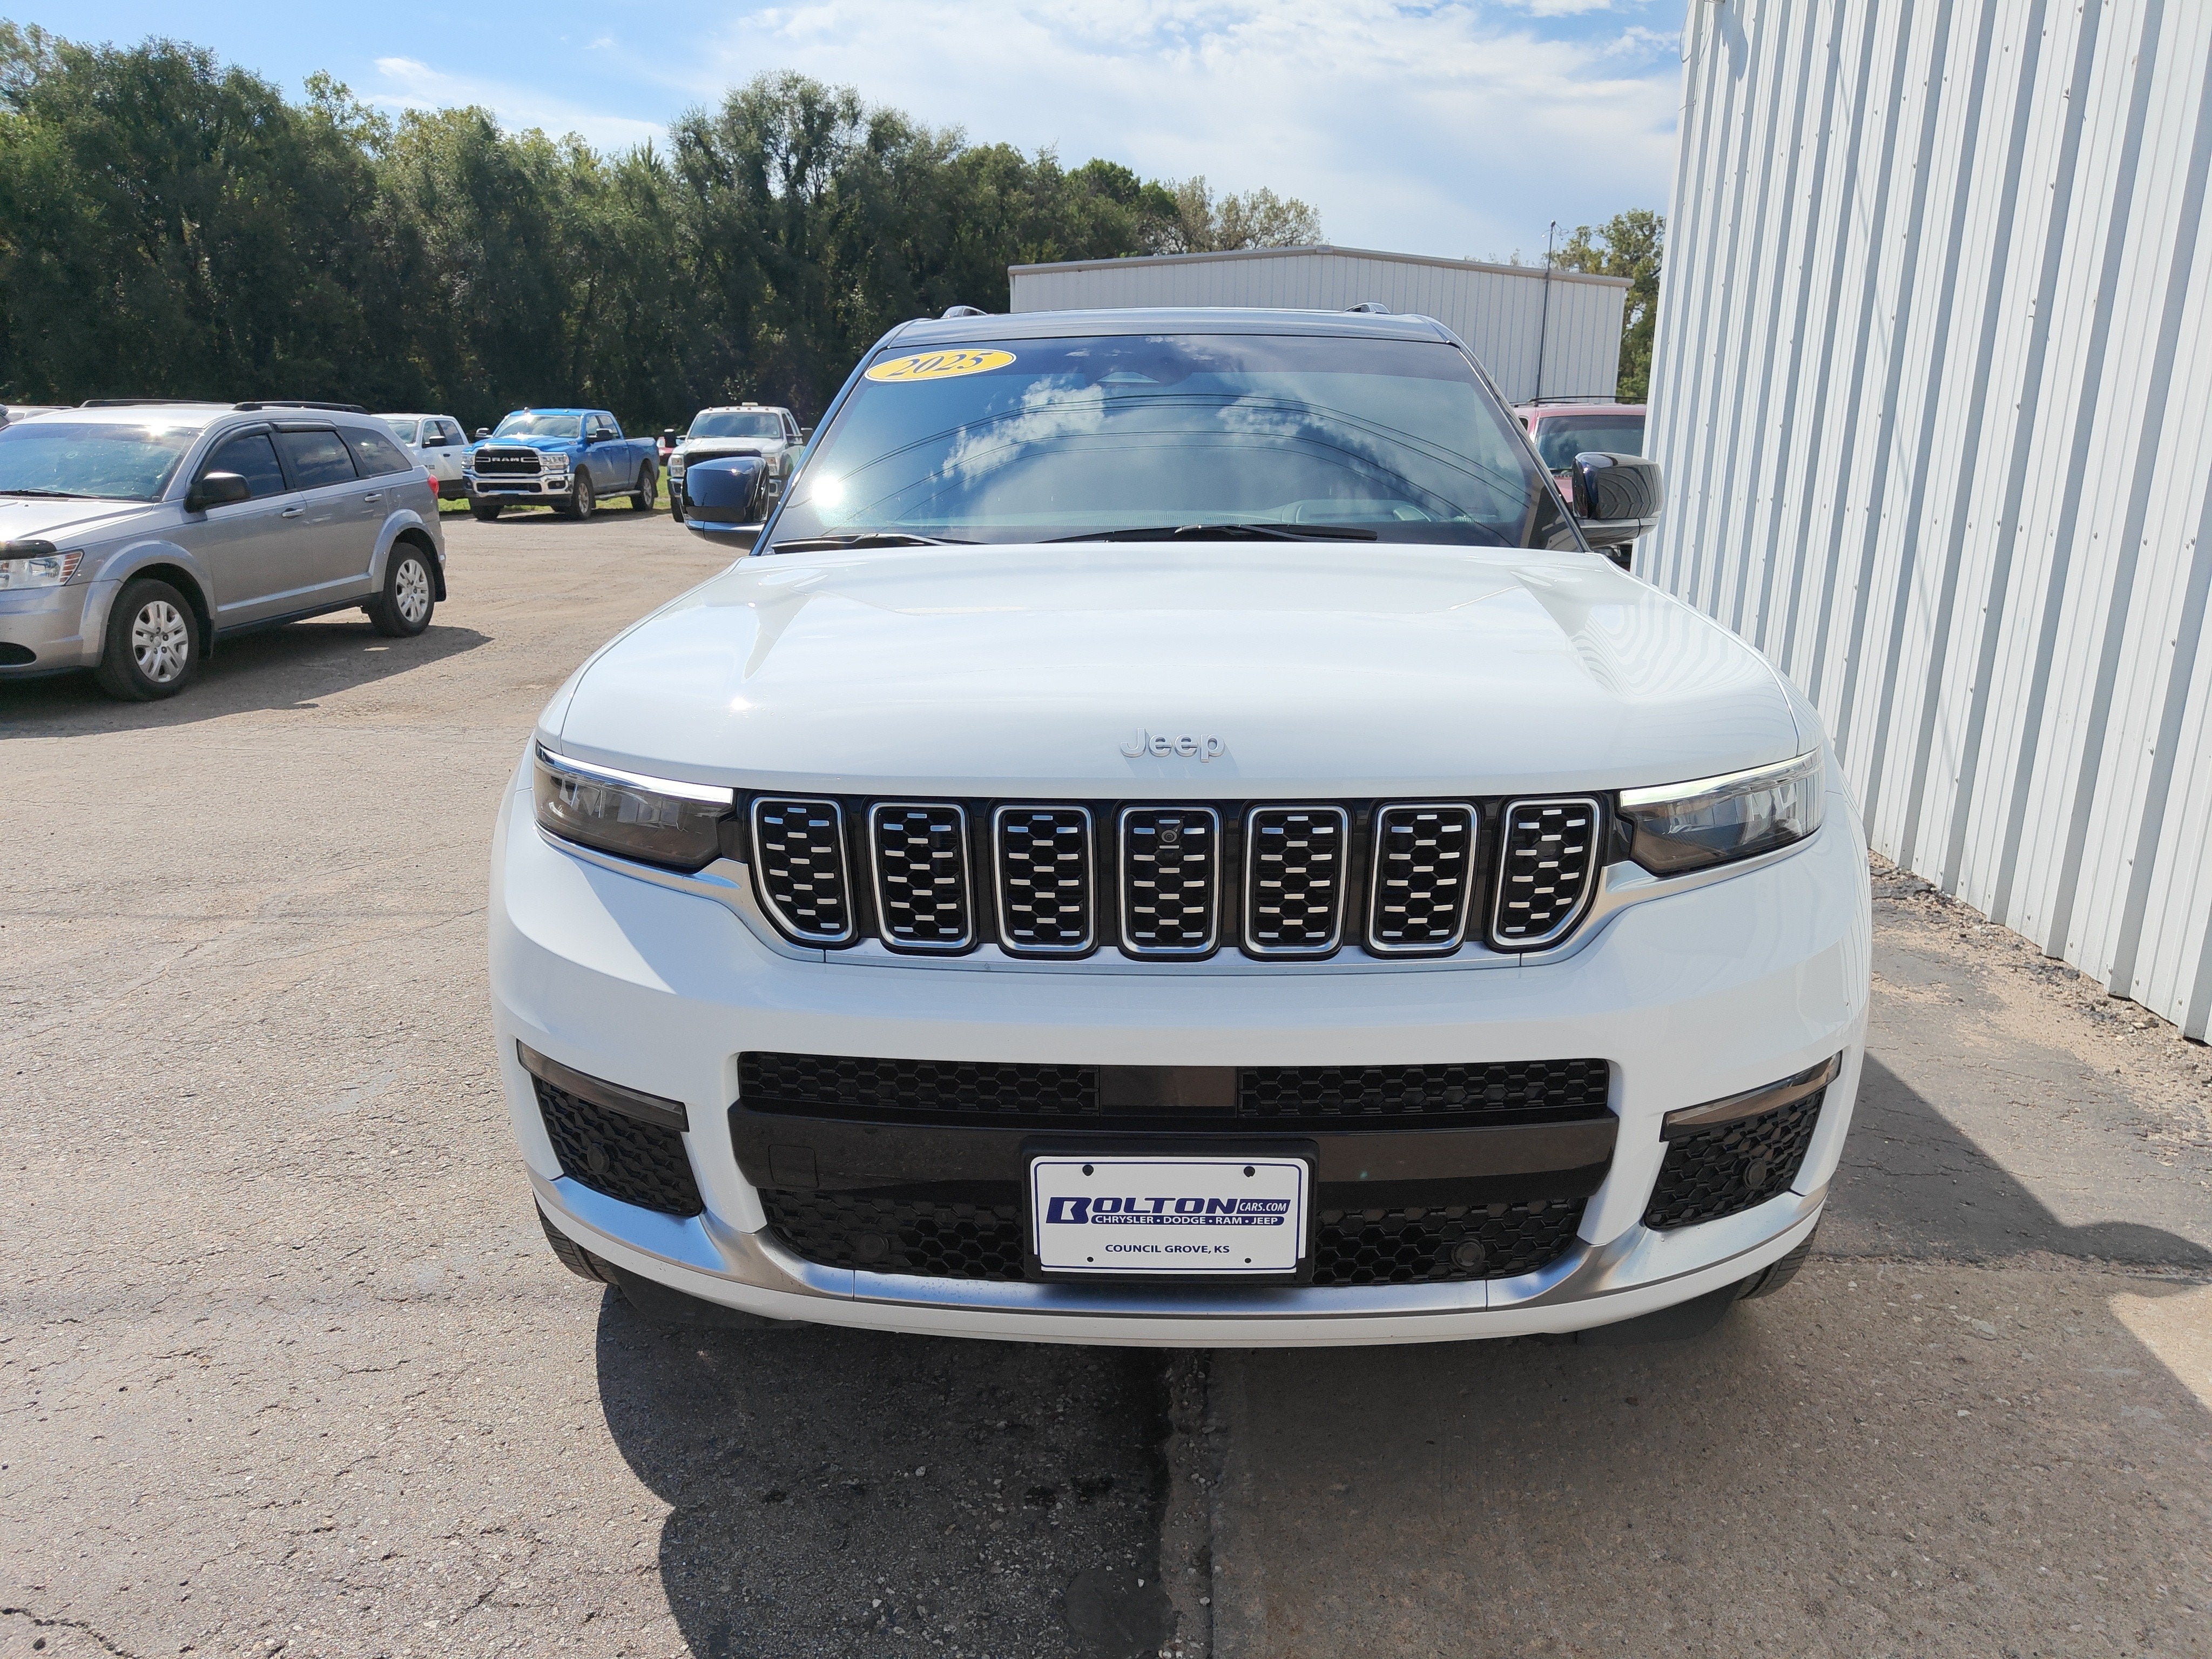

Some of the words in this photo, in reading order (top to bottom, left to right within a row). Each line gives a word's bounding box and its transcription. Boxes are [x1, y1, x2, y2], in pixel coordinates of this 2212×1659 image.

[885, 352, 995, 377] 2025
[1119, 727, 1225, 763] Jeep
[1046, 1197, 1238, 1224] BOLTON
[1239, 1202, 1287, 1212] CARS.COM
[1095, 1216, 1154, 1224] CHRYSLER
[1163, 1216, 1206, 1224] DODGE
[1216, 1217, 1242, 1225] RAM
[1251, 1217, 1278, 1225] JEEP
[1105, 1244, 1162, 1253] COUNCIL
[1164, 1245, 1212, 1254] GROVE,
[1214, 1245, 1230, 1253] KS
